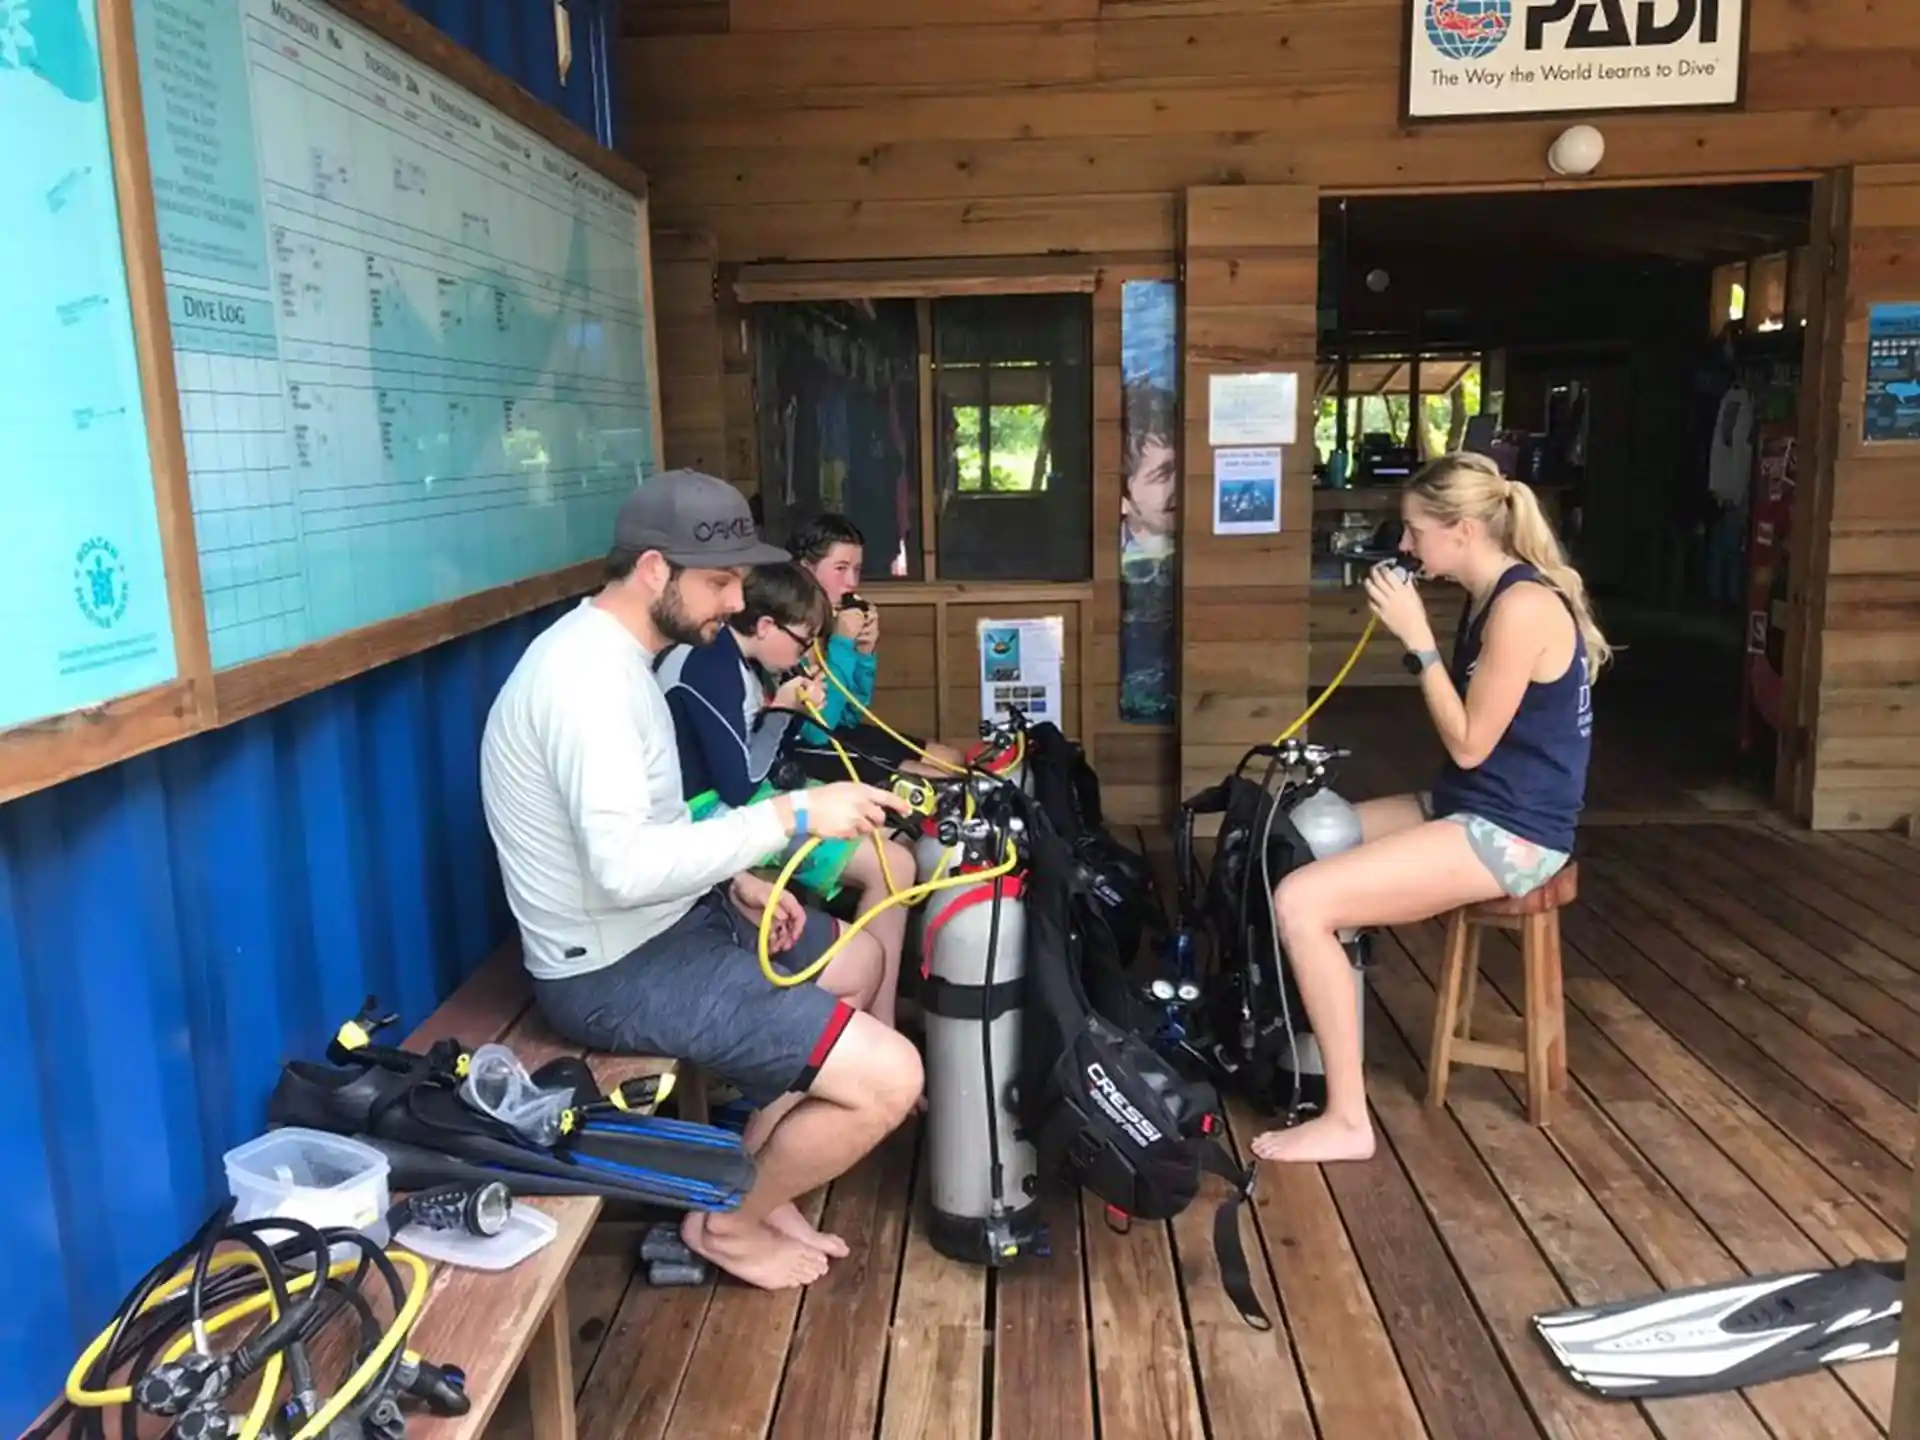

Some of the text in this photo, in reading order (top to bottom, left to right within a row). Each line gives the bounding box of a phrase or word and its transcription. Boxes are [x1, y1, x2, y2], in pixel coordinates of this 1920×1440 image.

[1525, 0, 1719, 50] PADI
[1431, 58, 1716, 89] The Way the World Learns to Dive
[183, 296, 245, 324] DIVE LOG
[1087, 1062, 1163, 1142] CRESSI
